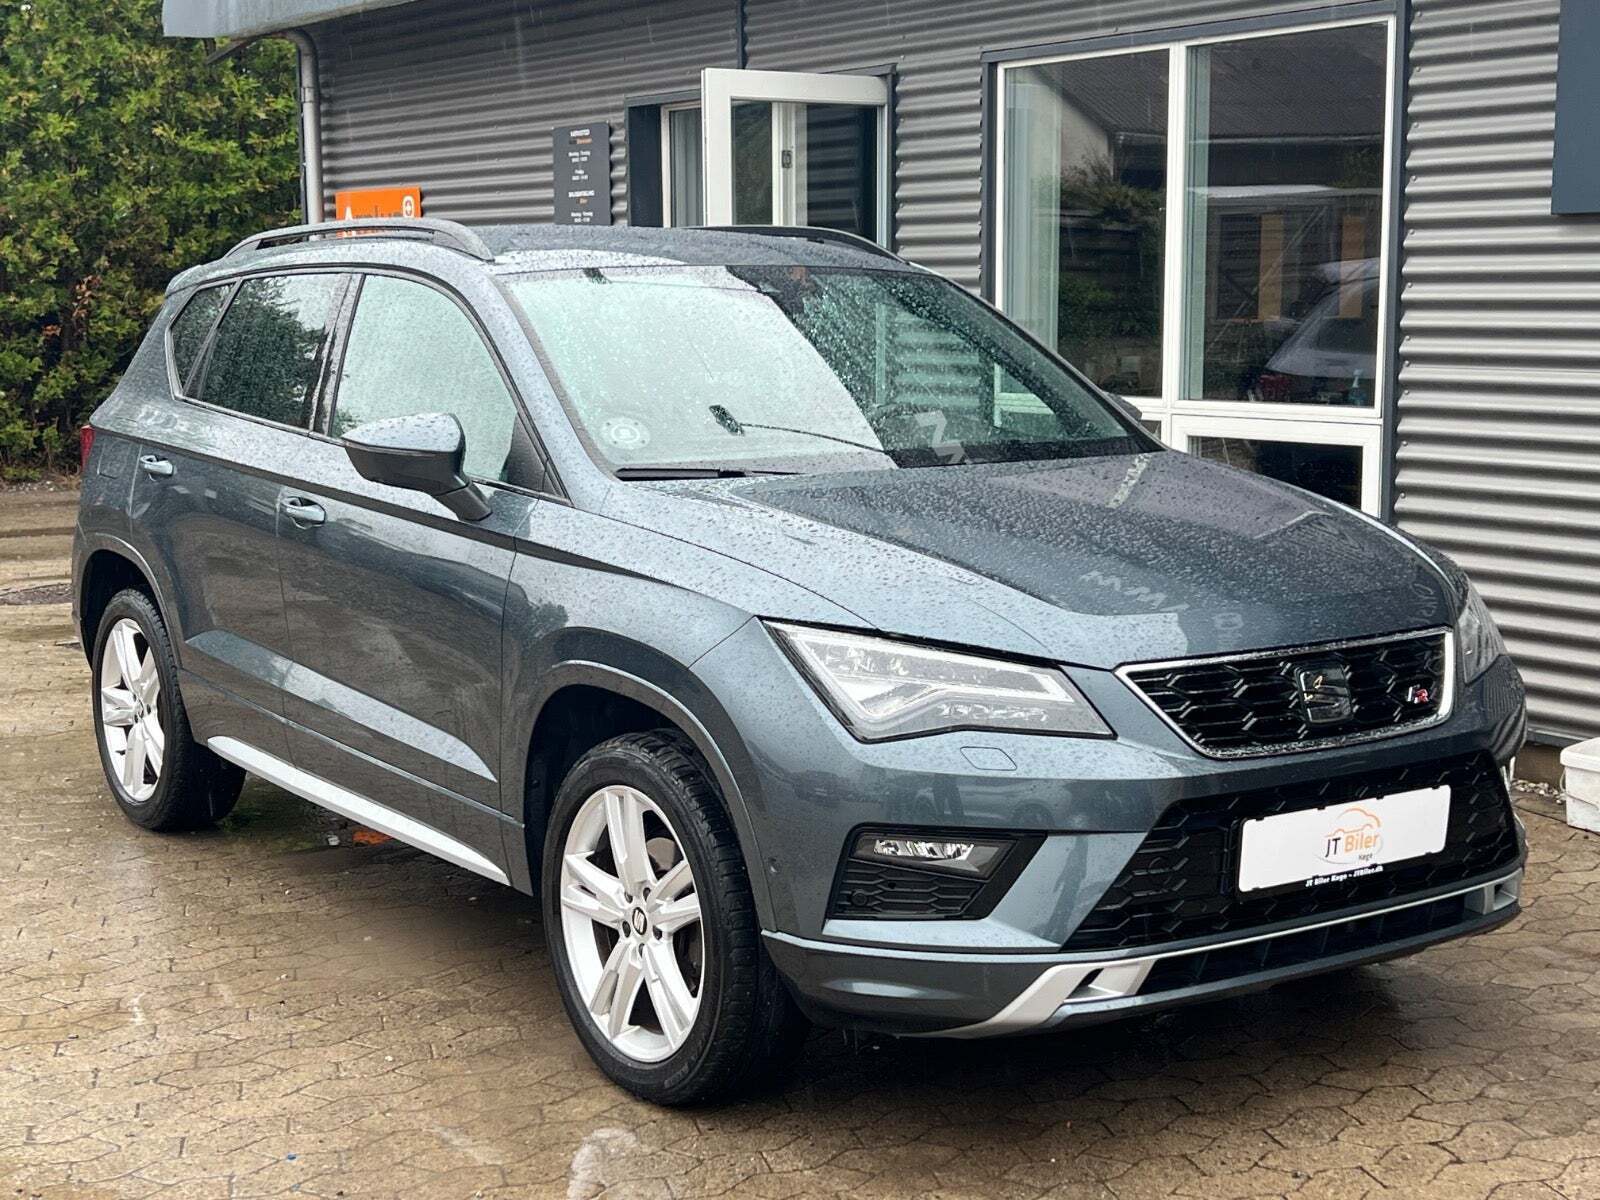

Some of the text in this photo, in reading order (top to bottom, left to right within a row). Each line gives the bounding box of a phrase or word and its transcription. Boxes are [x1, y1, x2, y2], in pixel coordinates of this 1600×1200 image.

[1325, 832, 1379, 858] JT Biler
[1305, 879, 1313, 887] JT
